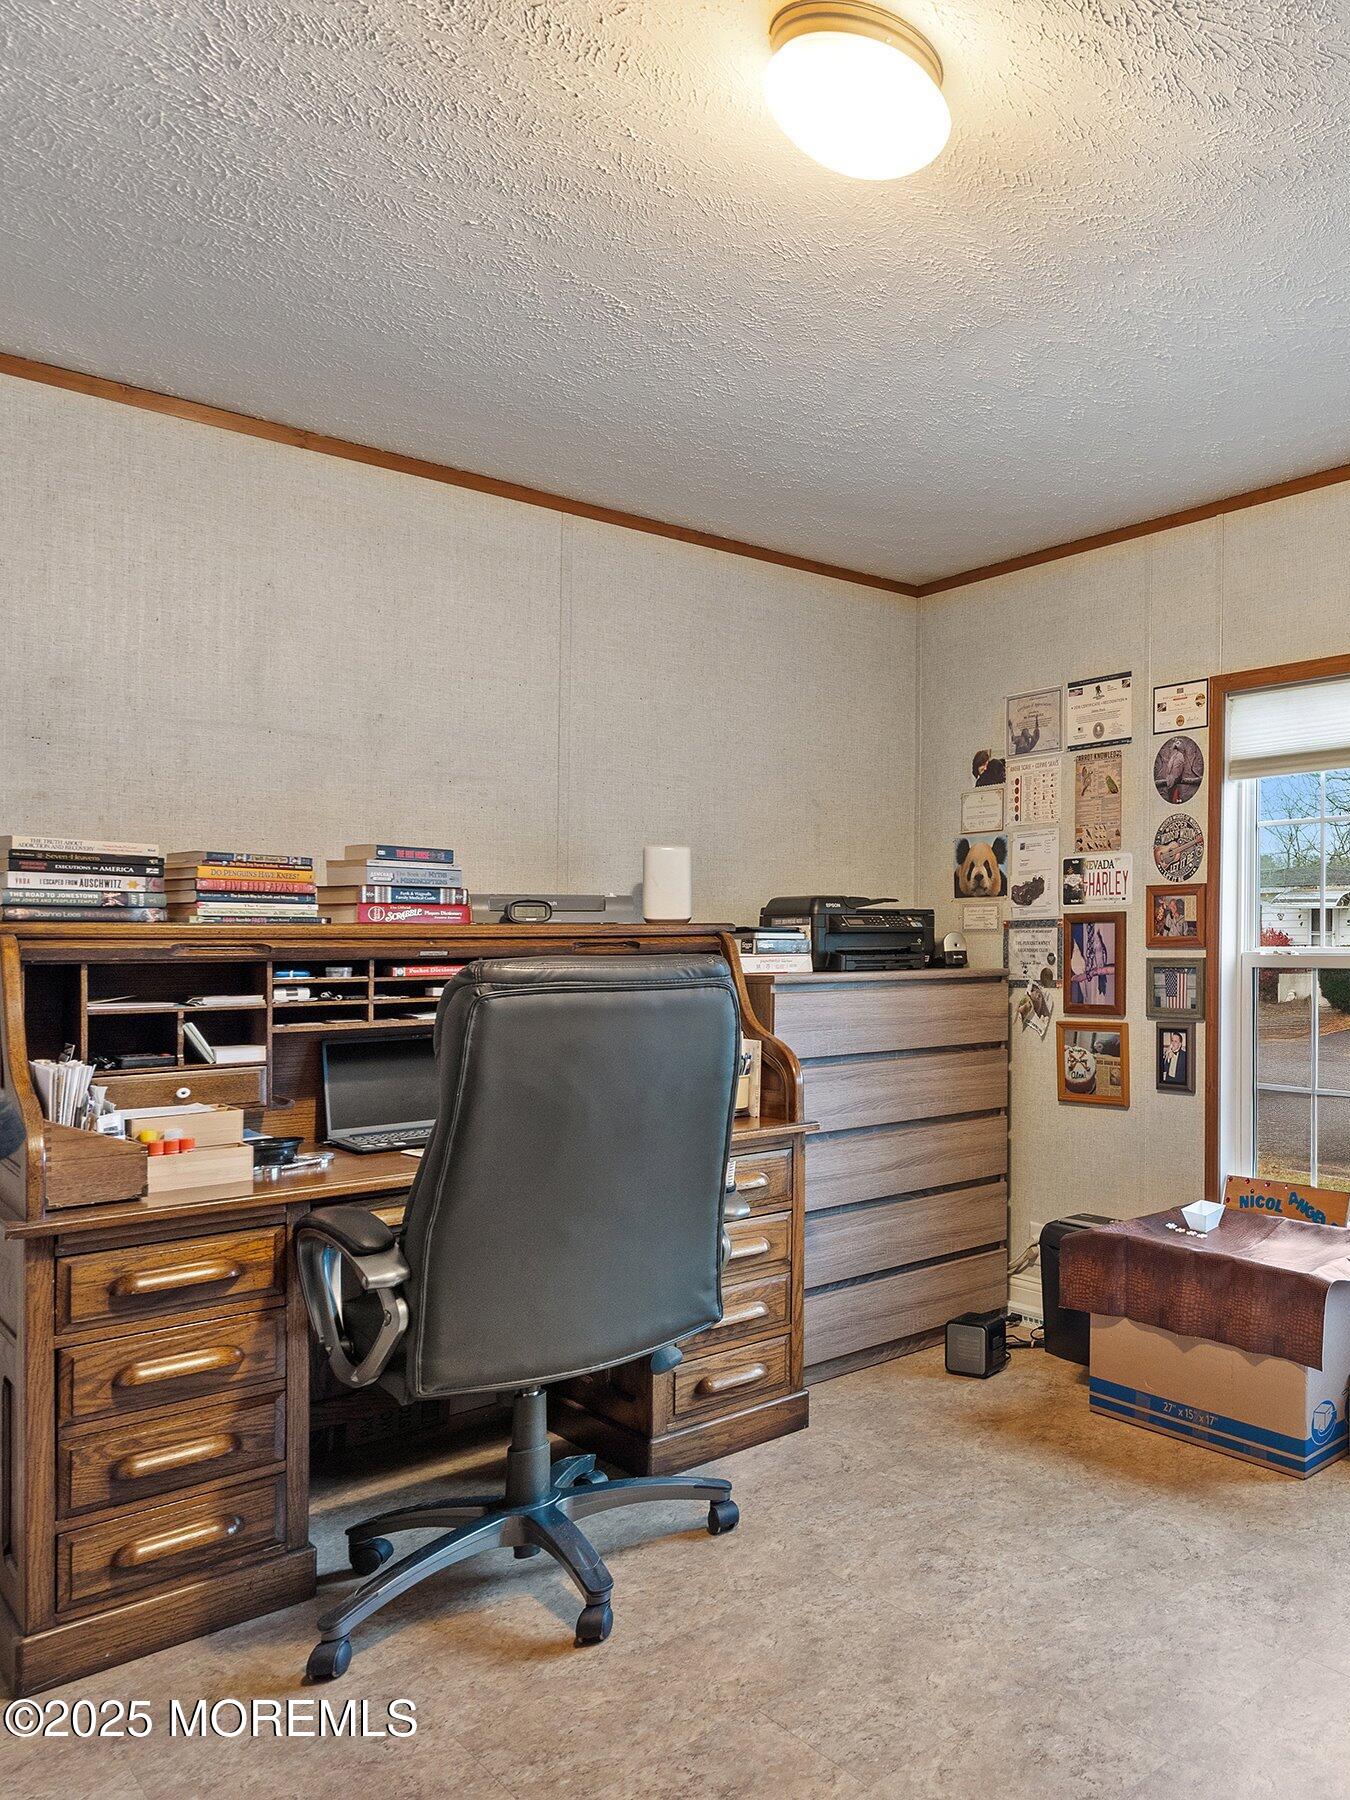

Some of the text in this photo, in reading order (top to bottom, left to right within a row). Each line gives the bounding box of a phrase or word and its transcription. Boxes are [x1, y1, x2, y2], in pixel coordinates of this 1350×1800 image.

[1084, 860, 1114, 870] NEVADA
[223, 870, 257, 878] PENGUINS
[259, 871, 275, 879] HAVE
[79, 878, 122, 889] AUSCHWITZ
